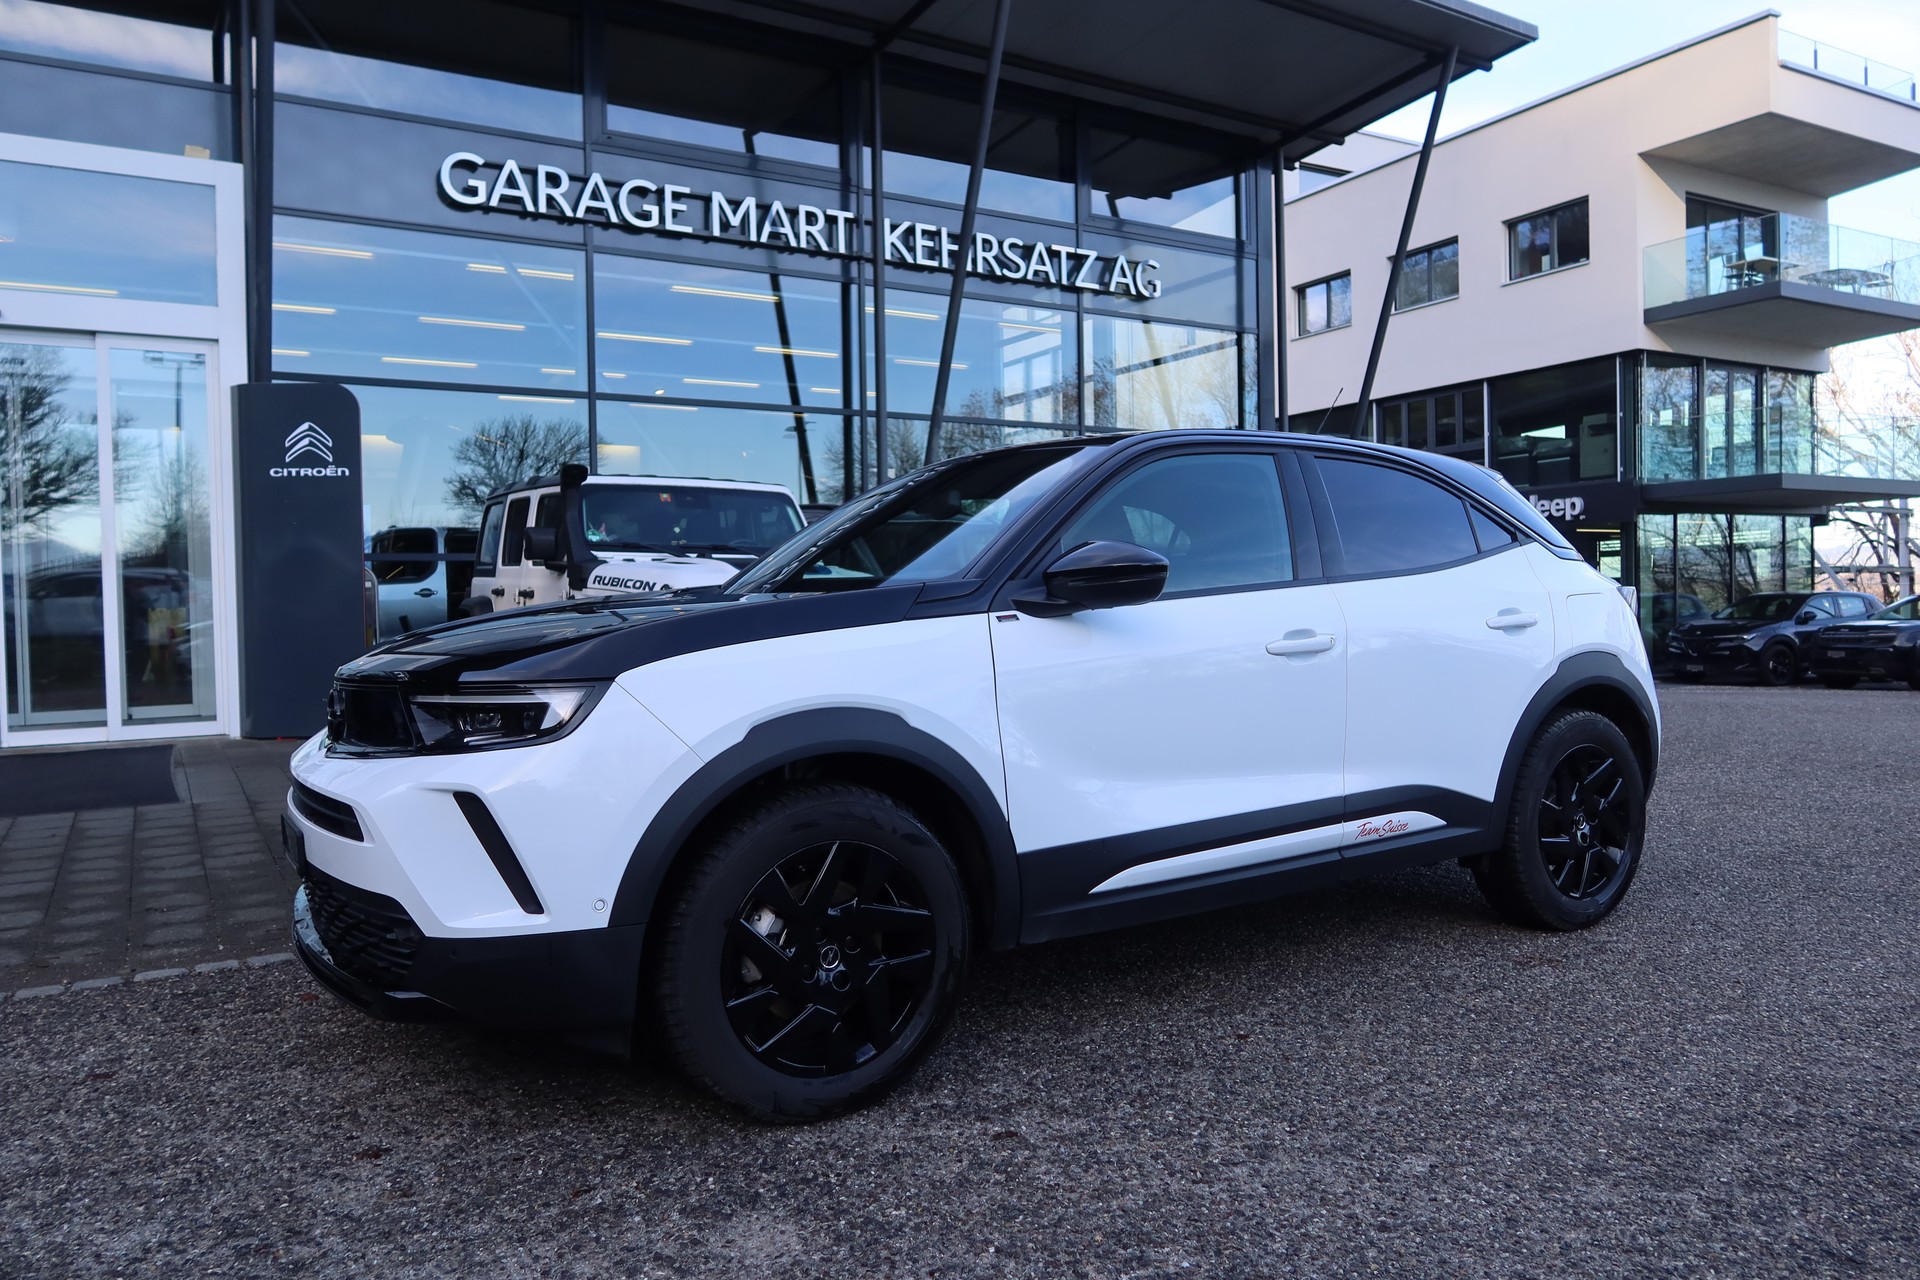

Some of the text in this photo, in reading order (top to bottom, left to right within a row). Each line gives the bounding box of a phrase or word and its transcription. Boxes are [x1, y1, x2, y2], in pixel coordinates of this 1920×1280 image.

[440, 152, 693, 233] GARAGE
[711, 191, 854, 253] MART
[1109, 255, 1162, 298] AG
[593, 575, 656, 591] RUBICON
